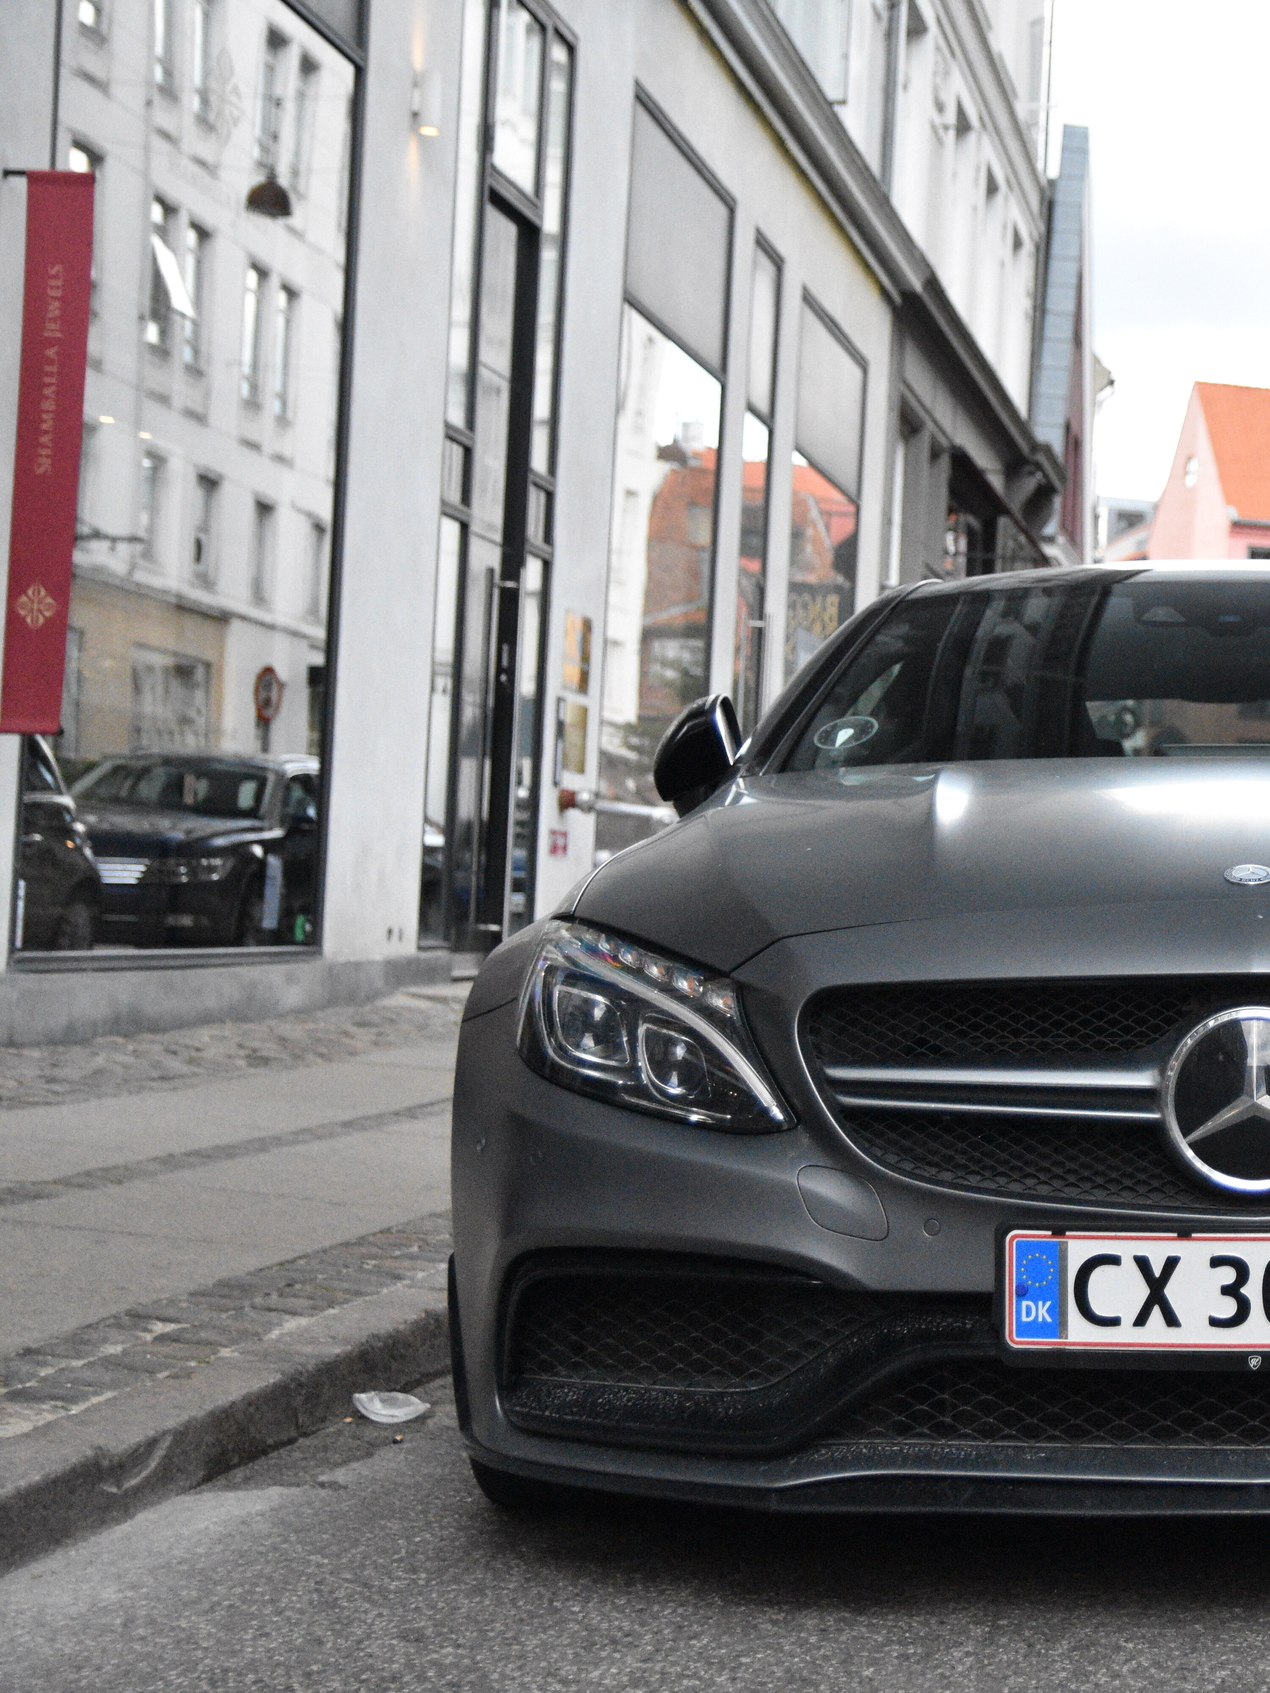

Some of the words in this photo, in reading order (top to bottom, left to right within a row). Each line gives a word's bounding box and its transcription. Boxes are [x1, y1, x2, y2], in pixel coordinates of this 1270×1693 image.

[43, 263, 64, 338] JEWELS
[34, 344, 59, 476] SHAMBALLA
[1020, 1300, 1053, 1323] DK
[1073, 1252, 1182, 1329] CX
